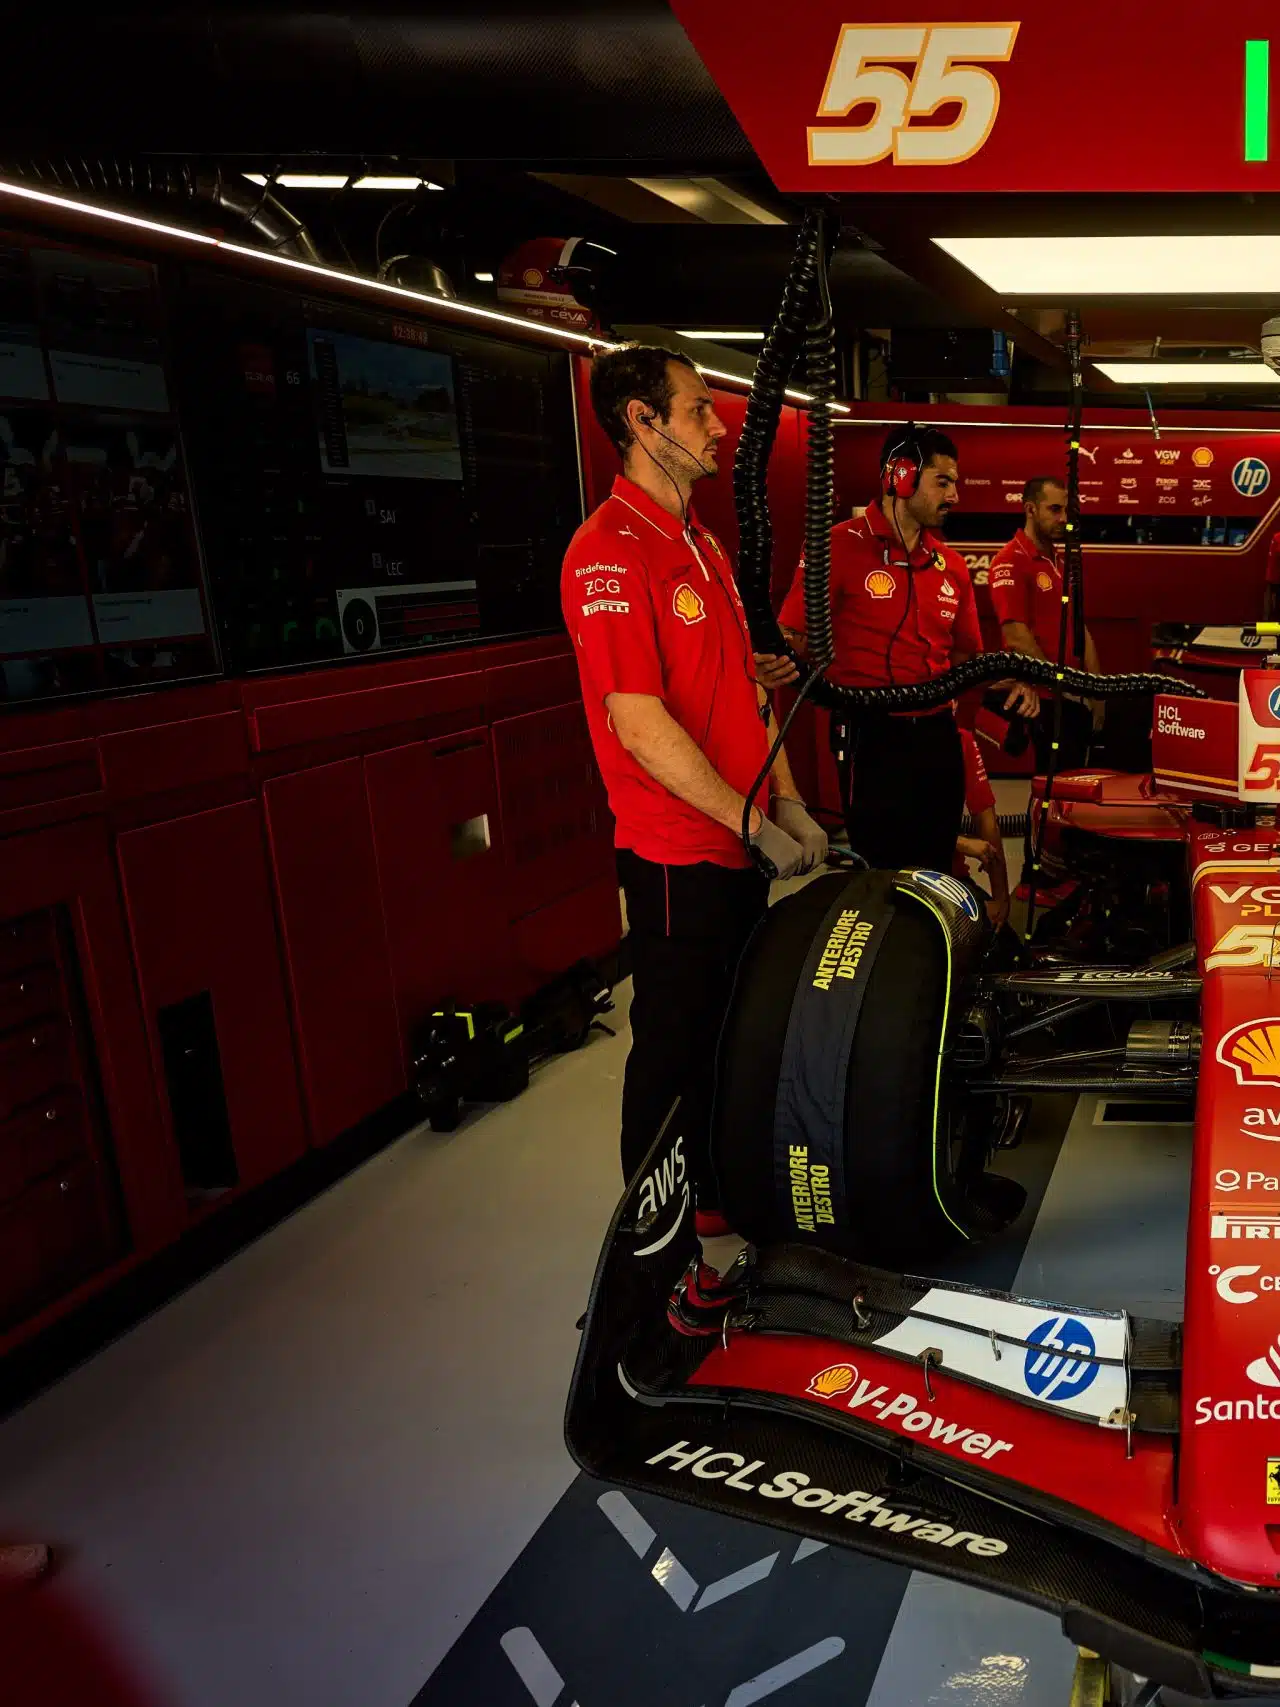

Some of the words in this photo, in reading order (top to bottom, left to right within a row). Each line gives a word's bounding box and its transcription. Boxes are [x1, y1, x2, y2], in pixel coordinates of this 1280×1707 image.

[806, 21, 1020, 166] 55
[1154, 449, 1181, 460] VGW
[1237, 459, 1265, 496] hp
[575, 562, 628, 578] Bitdefender
[584, 578, 620, 596] ZCG
[581, 600, 630, 617] PIRELLI
[1157, 720, 1206, 740] Software
[1158, 705, 1182, 722] HCL
[812, 909, 861, 991] ANTERIORE
[836, 921, 874, 980] DESTRO
[1081, 971, 1174, 980] ECOPOL
[638, 1135, 686, 1220] aws
[789, 1144, 817, 1232] ANTERIORE
[810, 1164, 835, 1225] DESTRO
[1027, 1316, 1098, 1400] hp
[849, 1378, 1015, 1461] V-Power
